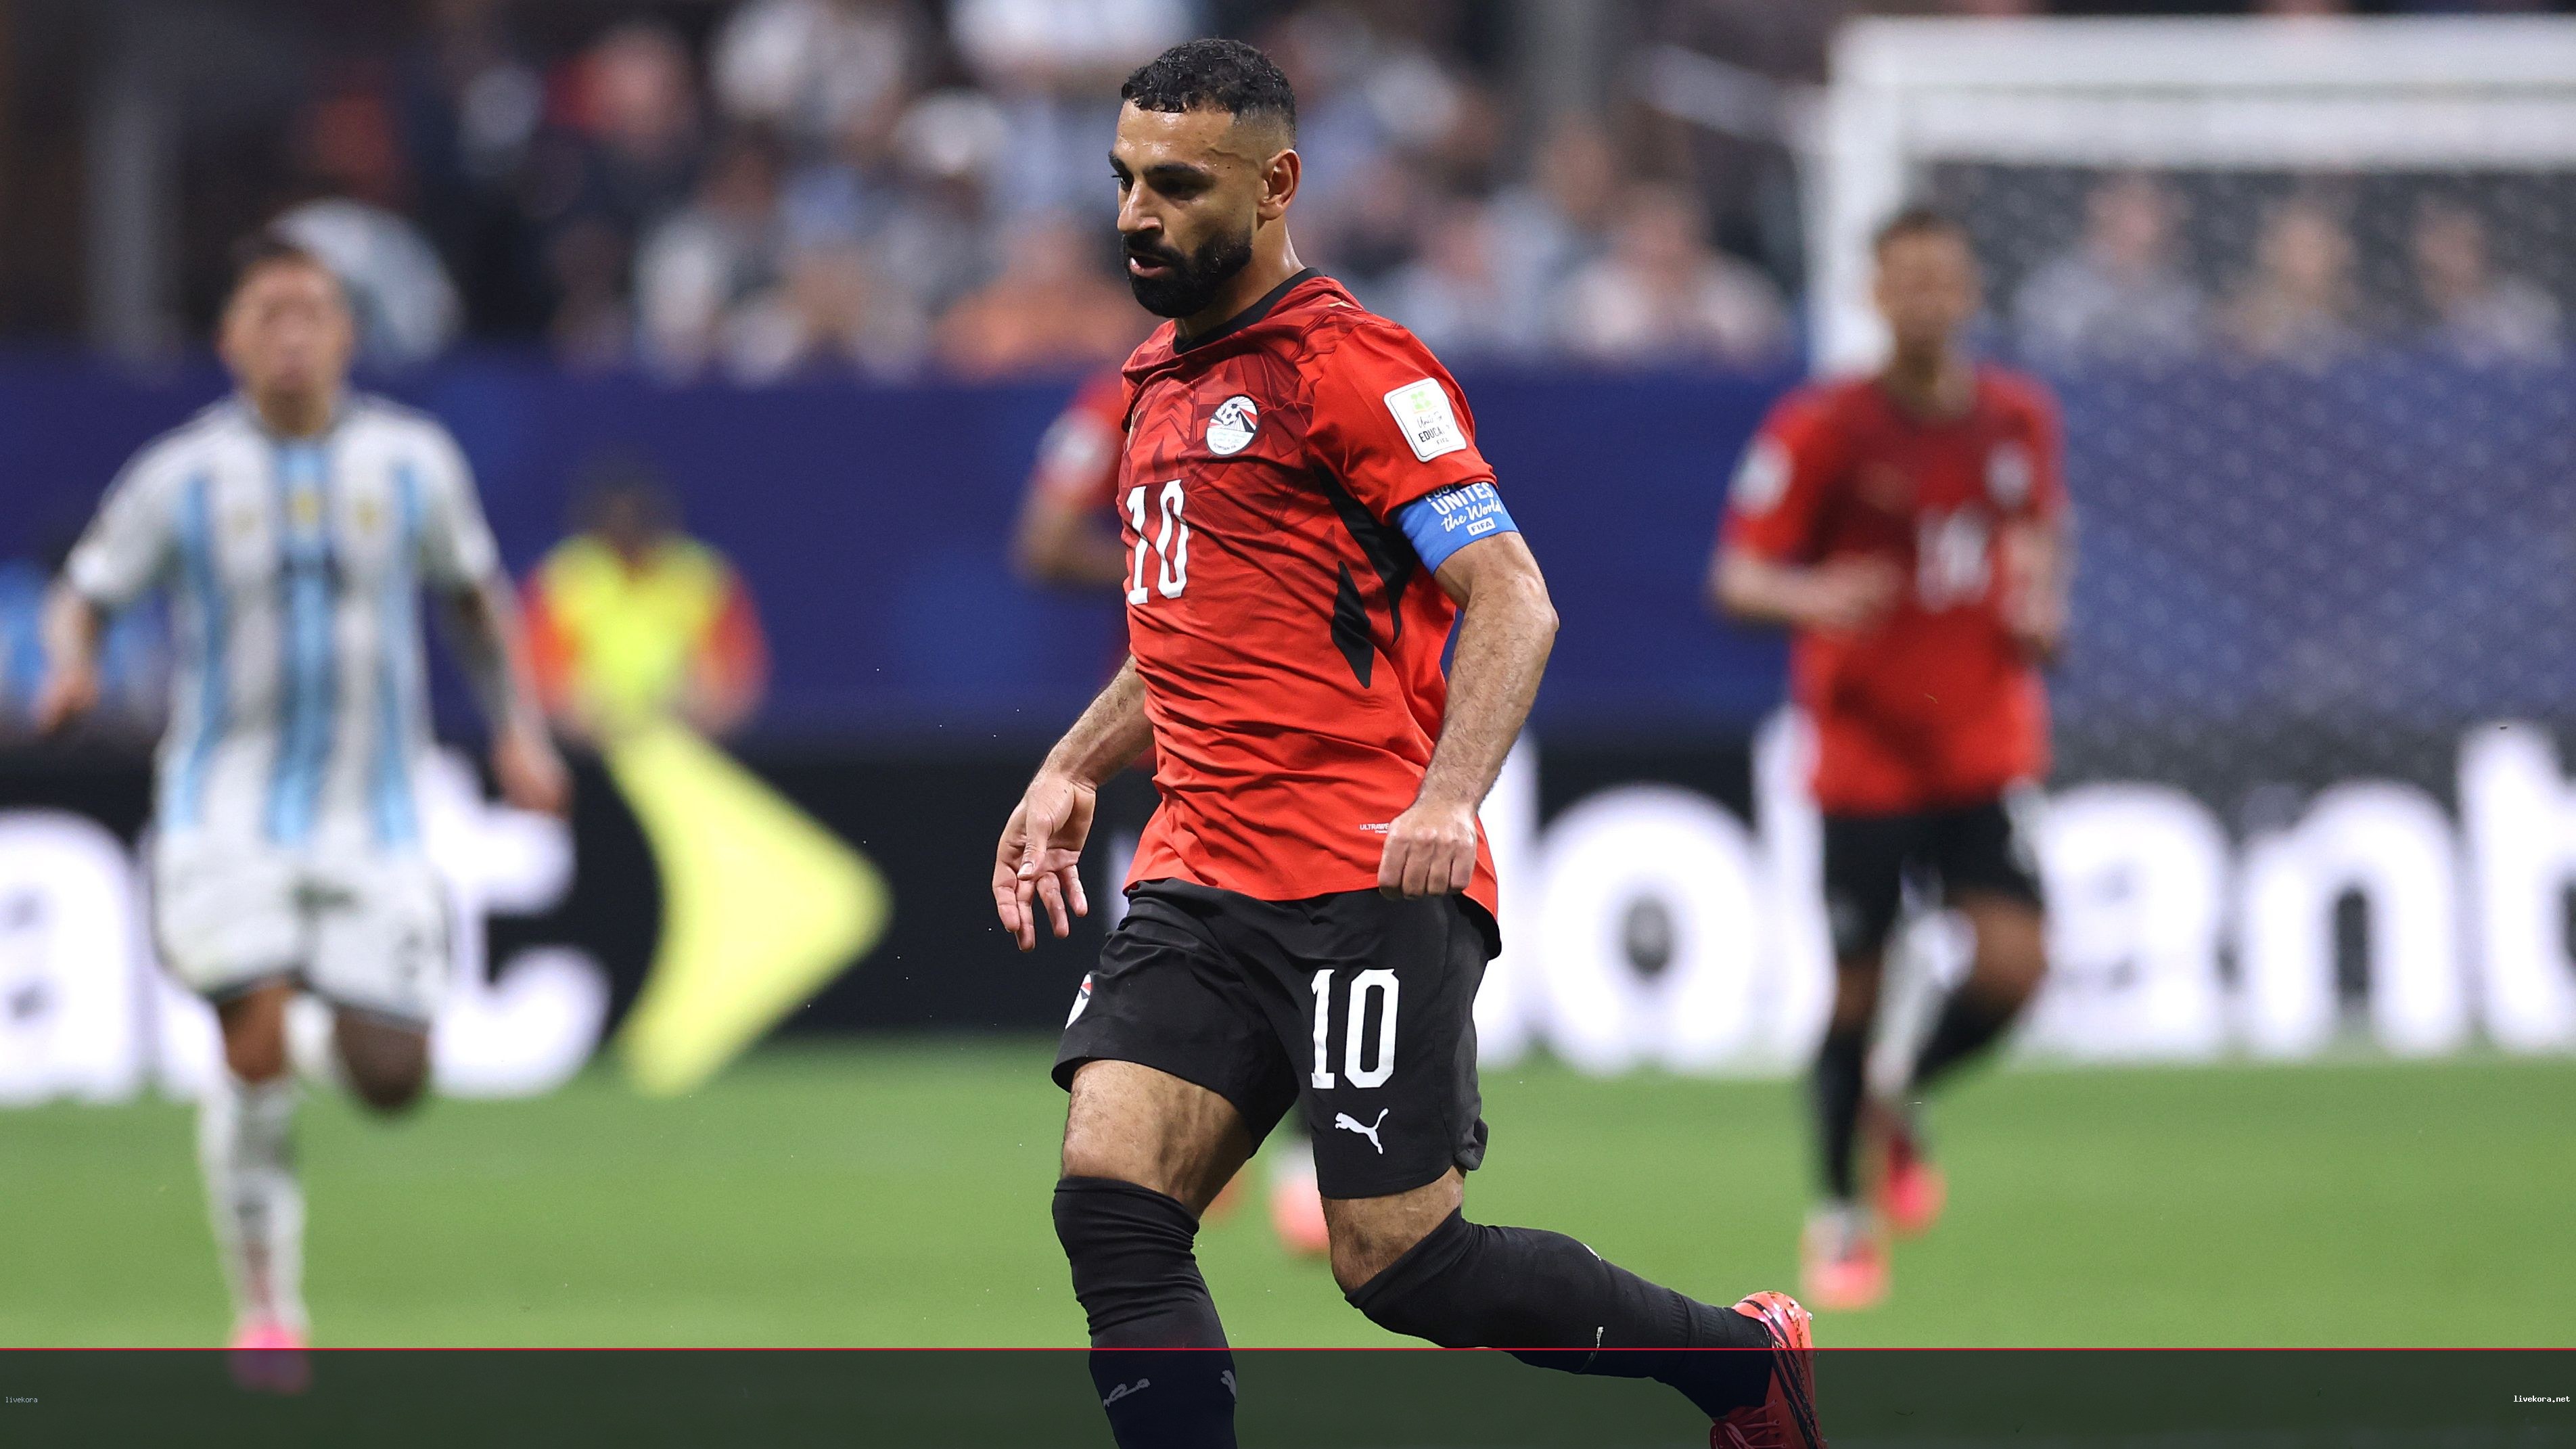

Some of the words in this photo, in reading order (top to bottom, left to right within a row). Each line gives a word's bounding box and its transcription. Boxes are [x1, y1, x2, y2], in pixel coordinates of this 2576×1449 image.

[1418, 424, 1450, 443] EDUCA
[1431, 482, 1494, 515] UNITES
[1440, 513, 1467, 532] the
[1465, 499, 1503, 521] World
[1471, 520, 1492, 533] FIFA
[1126, 479, 1189, 605] 10
[1360, 823, 1389, 831] ULTRAWE
[1310, 969, 1400, 1088] 10
